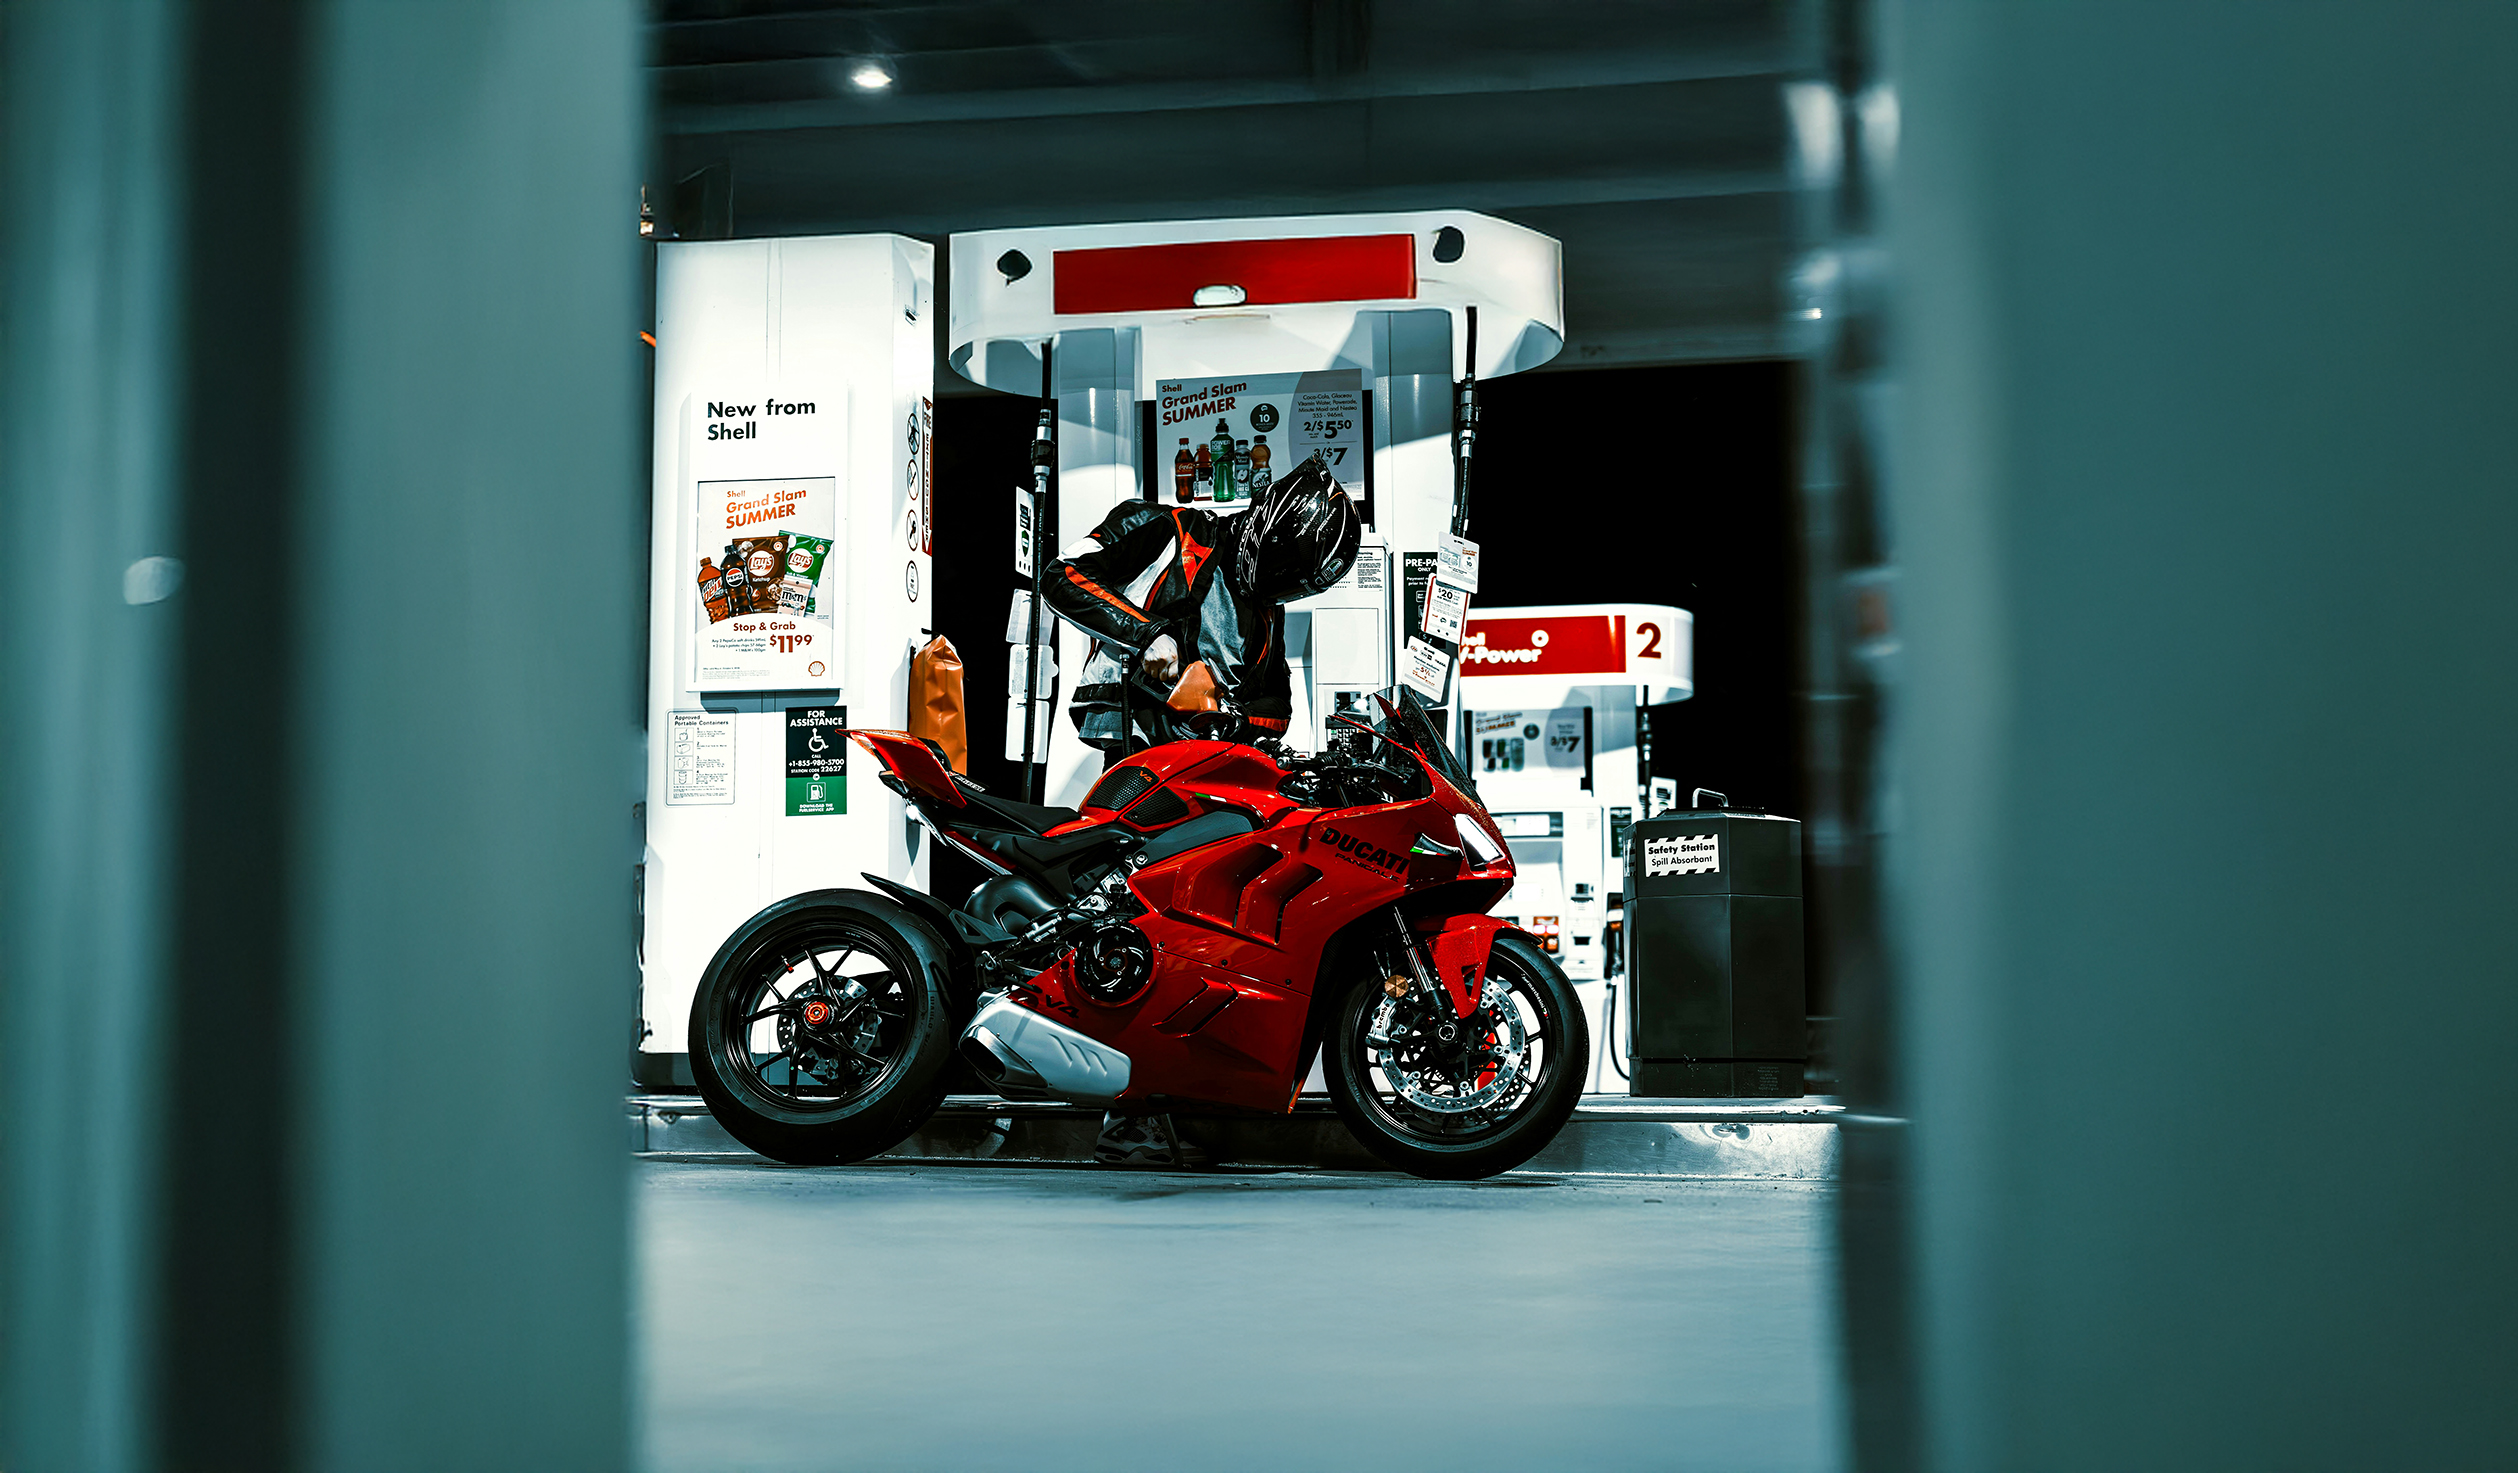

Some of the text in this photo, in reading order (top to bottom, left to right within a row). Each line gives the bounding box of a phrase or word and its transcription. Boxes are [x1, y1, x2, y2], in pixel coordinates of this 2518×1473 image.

[1162, 384, 1182, 392] Shell
[1162, 382, 1247, 409] Grand Slam
[707, 398, 816, 418] New from
[1162, 396, 1236, 426] SUMMER
[1259, 414, 1270, 423] 10
[707, 422, 756, 441] Shell
[726, 488, 806, 513] Grand Slam
[726, 503, 796, 529] SUMMER
[1405, 559, 1438, 567] PRE-PA
[1438, 588, 1453, 599] $20
[734, 621, 796, 633] Stop & Grab
[1636, 622, 1661, 659] 2
[790, 717, 843, 727] ASSISTANCE
[1319, 827, 1410, 875] DUCATI
[1648, 843, 1715, 854] Safety Station
[1652, 855, 1712, 867] Spill Absorbant
